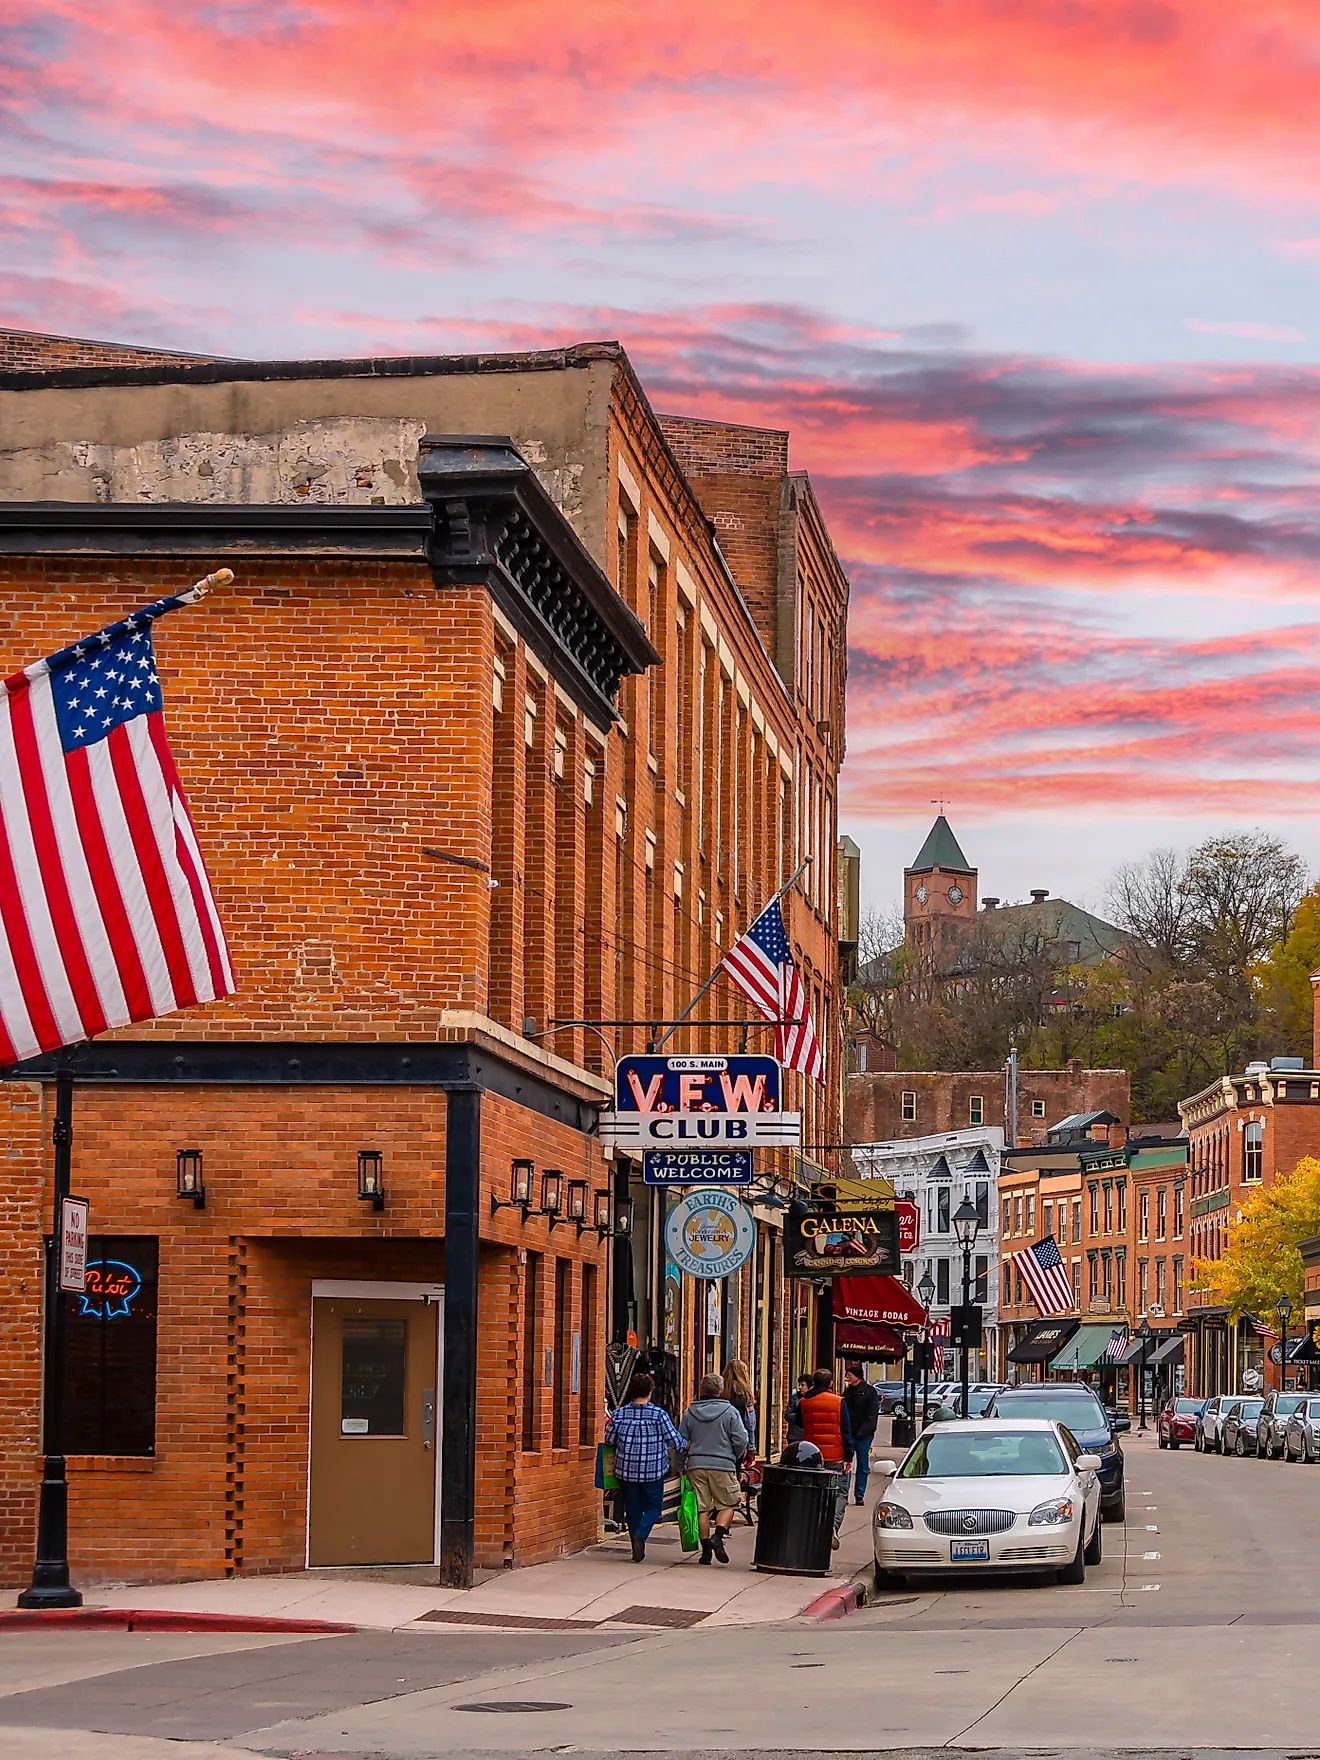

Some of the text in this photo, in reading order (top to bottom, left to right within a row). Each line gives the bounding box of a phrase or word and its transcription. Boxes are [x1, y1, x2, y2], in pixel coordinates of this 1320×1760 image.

[670, 1060, 725, 1068] 100 S. MAIN
[649, 1119, 748, 1139] CLUB
[665, 1154, 731, 1165] PUBLIC
[652, 1167, 744, 1178] WELCOME
[685, 1194, 738, 1212] EARTH'S
[70, 1211, 80, 1229] NO
[800, 1216, 881, 1238] GALENA
[66, 1229, 84, 1249] PARKING
[688, 1234, 730, 1242] JEWELRY
[675, 1246, 744, 1275] TREASURES
[807, 1257, 879, 1267] CANNING COMPANY
[84, 1270, 133, 1295] Pabst
[845, 1306, 909, 1321] VINTAGE SODAS
